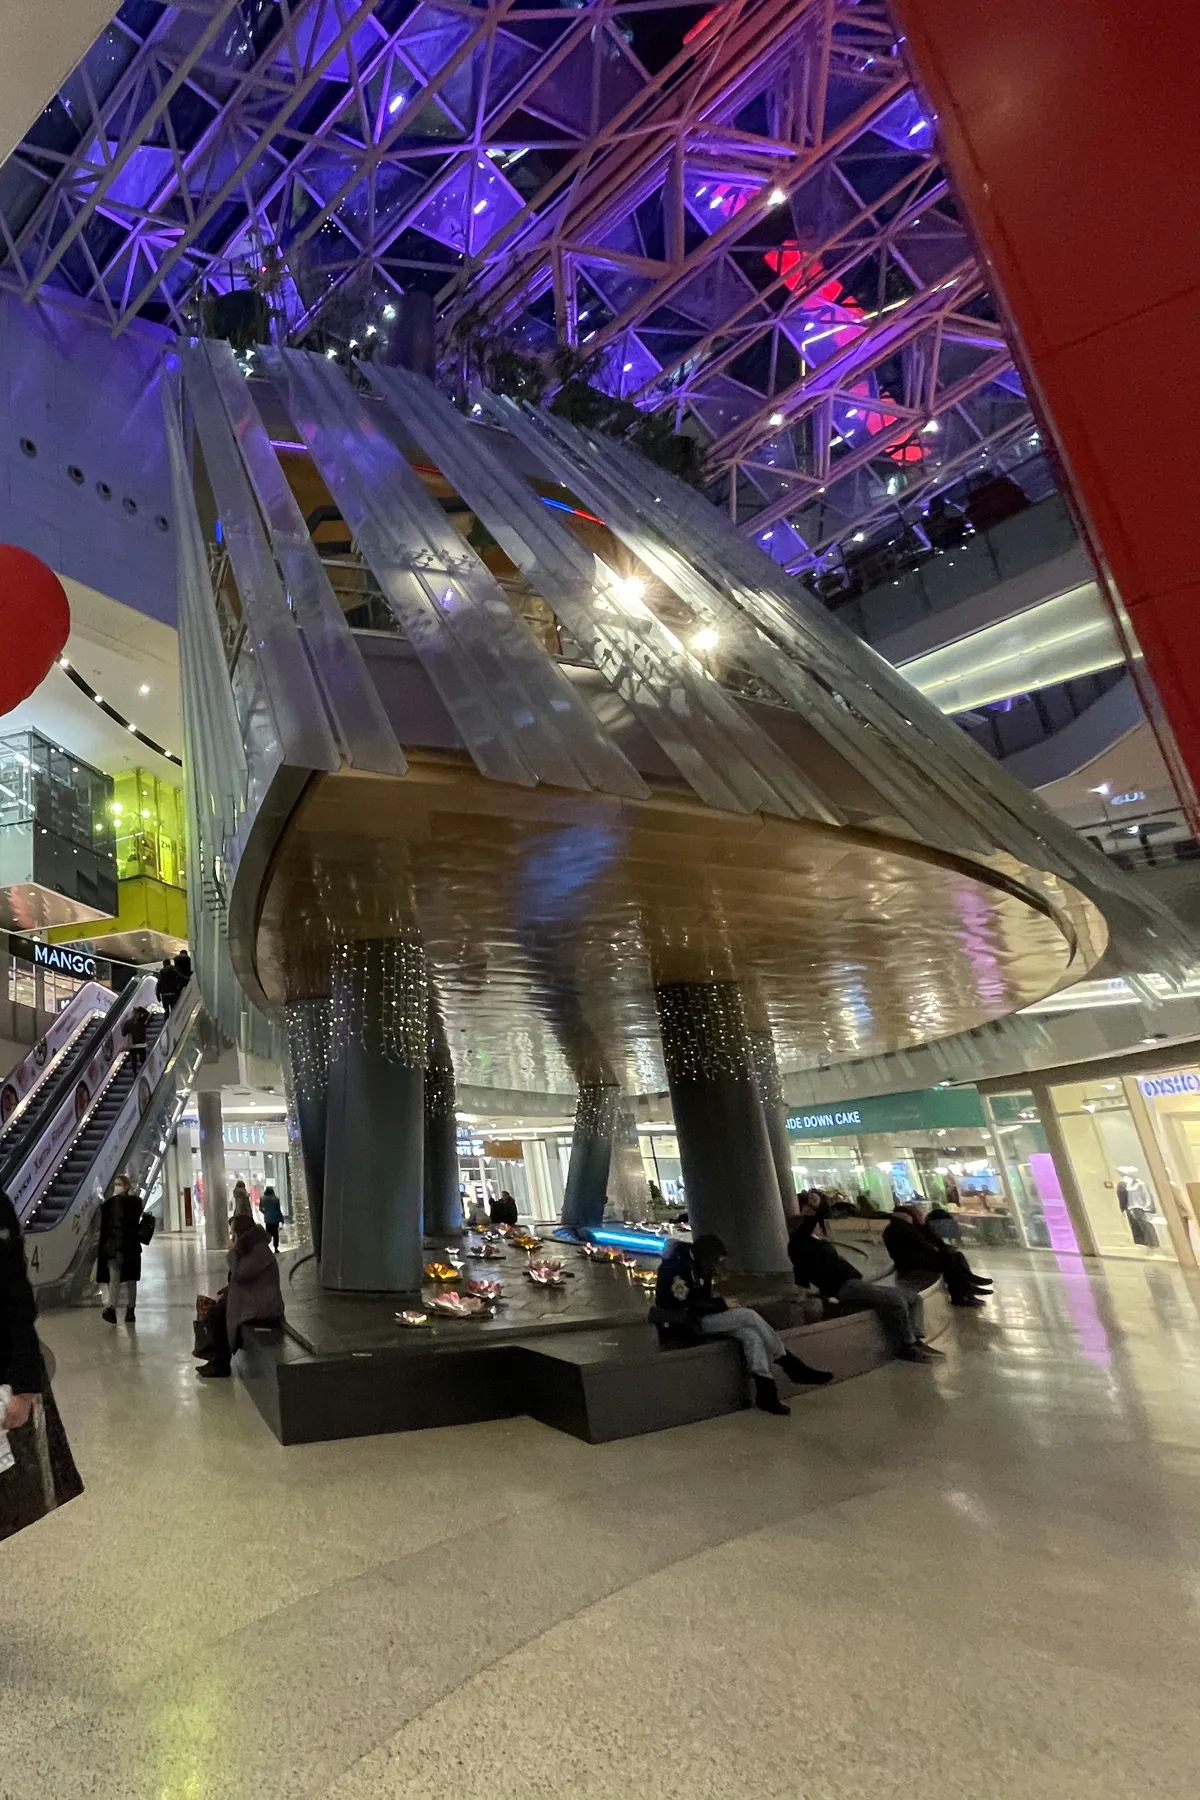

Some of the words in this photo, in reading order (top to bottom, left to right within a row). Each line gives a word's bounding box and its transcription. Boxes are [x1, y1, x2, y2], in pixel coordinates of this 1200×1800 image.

[34, 944, 96, 976] MANGO
[803, 1113, 834, 1128] DOWN
[834, 1111, 861, 1125] CAKE
[30, 1245, 40, 1273] 4
